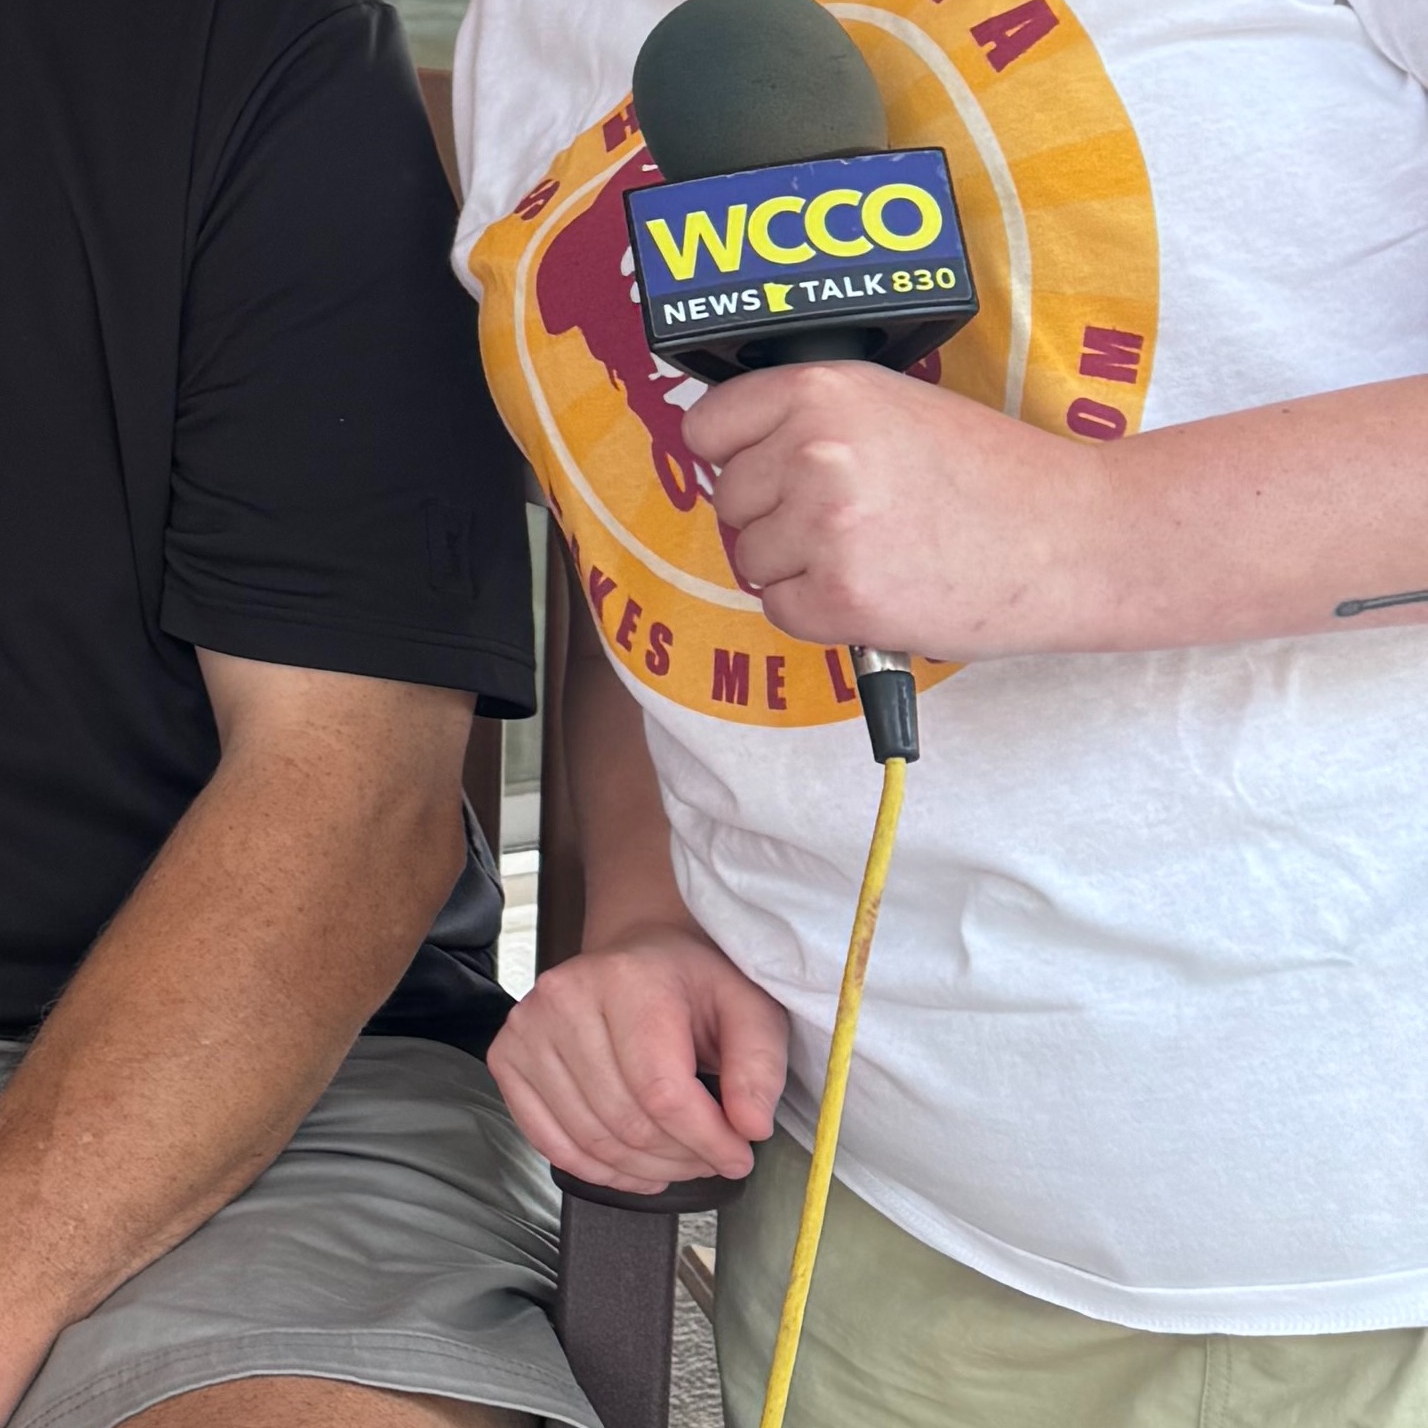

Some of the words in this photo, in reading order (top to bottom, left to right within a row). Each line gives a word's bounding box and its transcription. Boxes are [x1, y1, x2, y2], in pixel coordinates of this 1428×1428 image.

[646, 183, 943, 281] WCCO
[663, 289, 761, 326] NEWS
[799, 273, 887, 303] TALK
[891, 267, 957, 293] 830
[711, 648, 787, 711] ME
